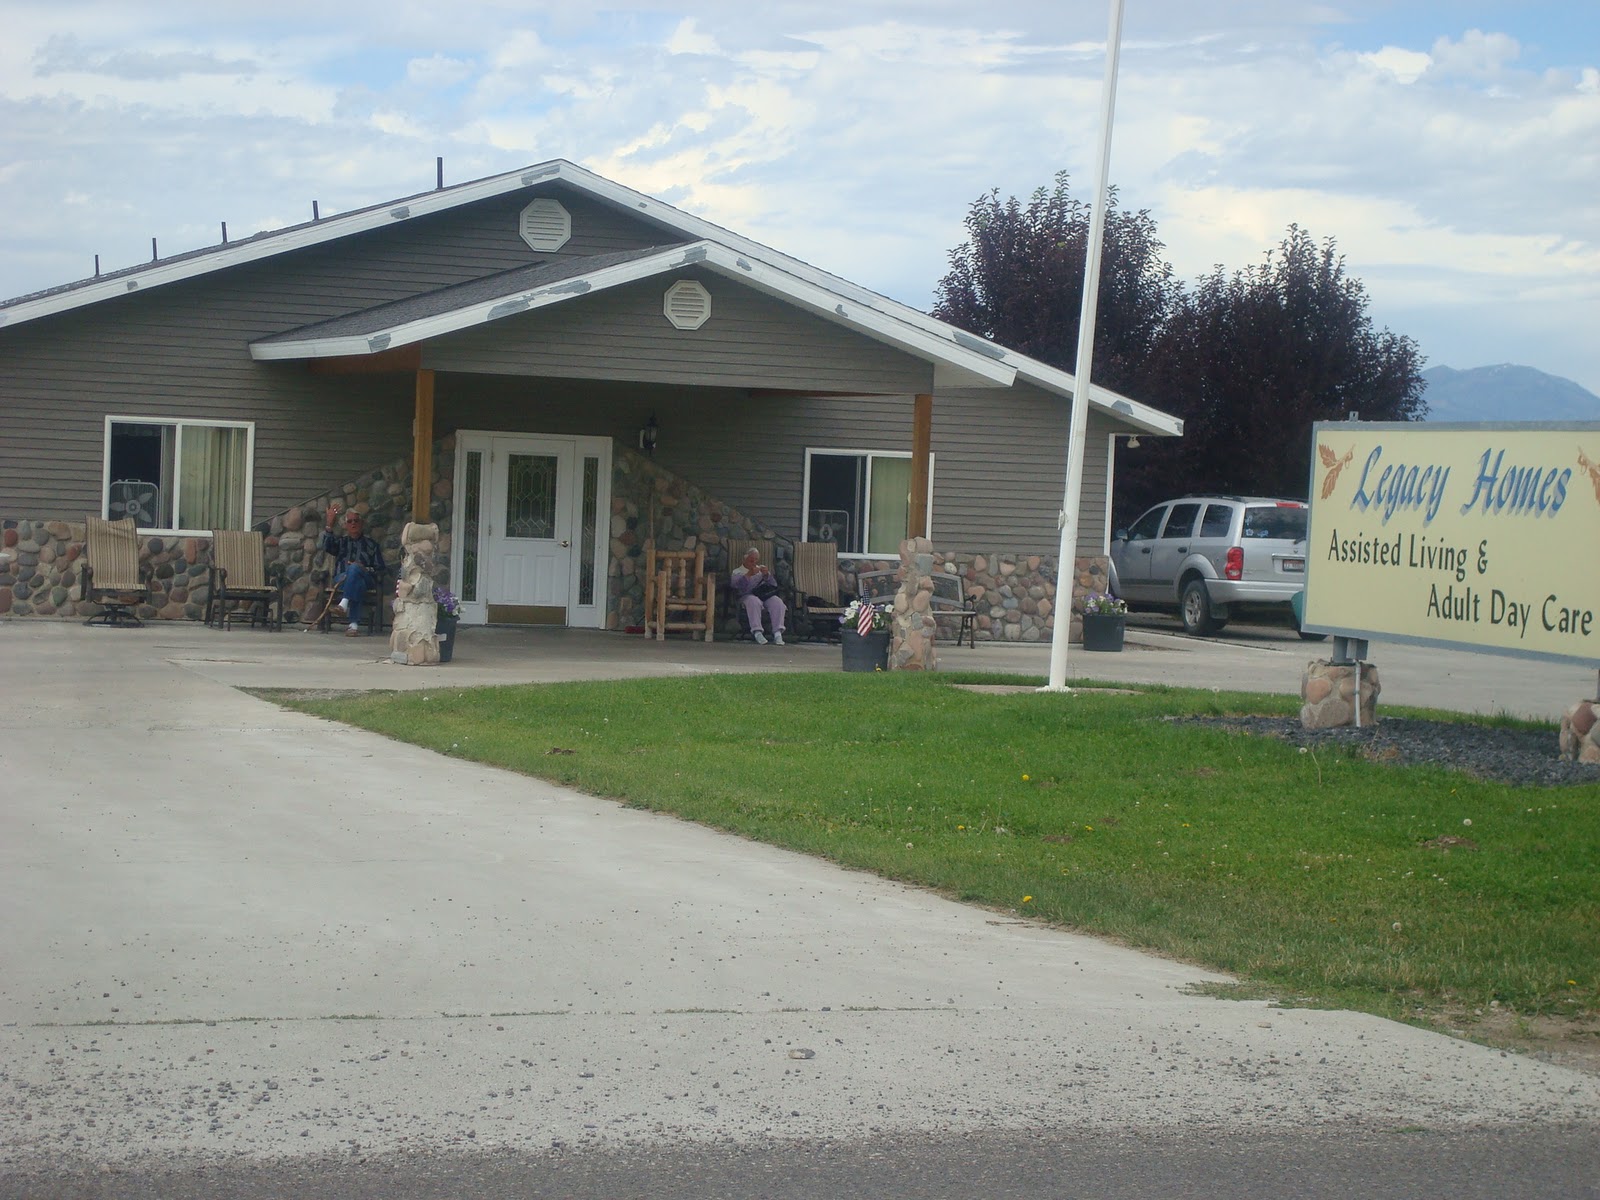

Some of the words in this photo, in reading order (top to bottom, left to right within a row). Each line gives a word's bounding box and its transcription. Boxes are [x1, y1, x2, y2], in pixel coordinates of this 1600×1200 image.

[1351, 445, 1451, 526] Legacy
[1461, 448, 1572, 518] Homes
[1328, 528, 1402, 566] Assisted
[1409, 533, 1467, 582] Living
[1477, 539, 1488, 574] &
[1427, 583, 1480, 623] Adult
[1490, 589, 1531, 639] Day
[1541, 594, 1593, 636] Care
